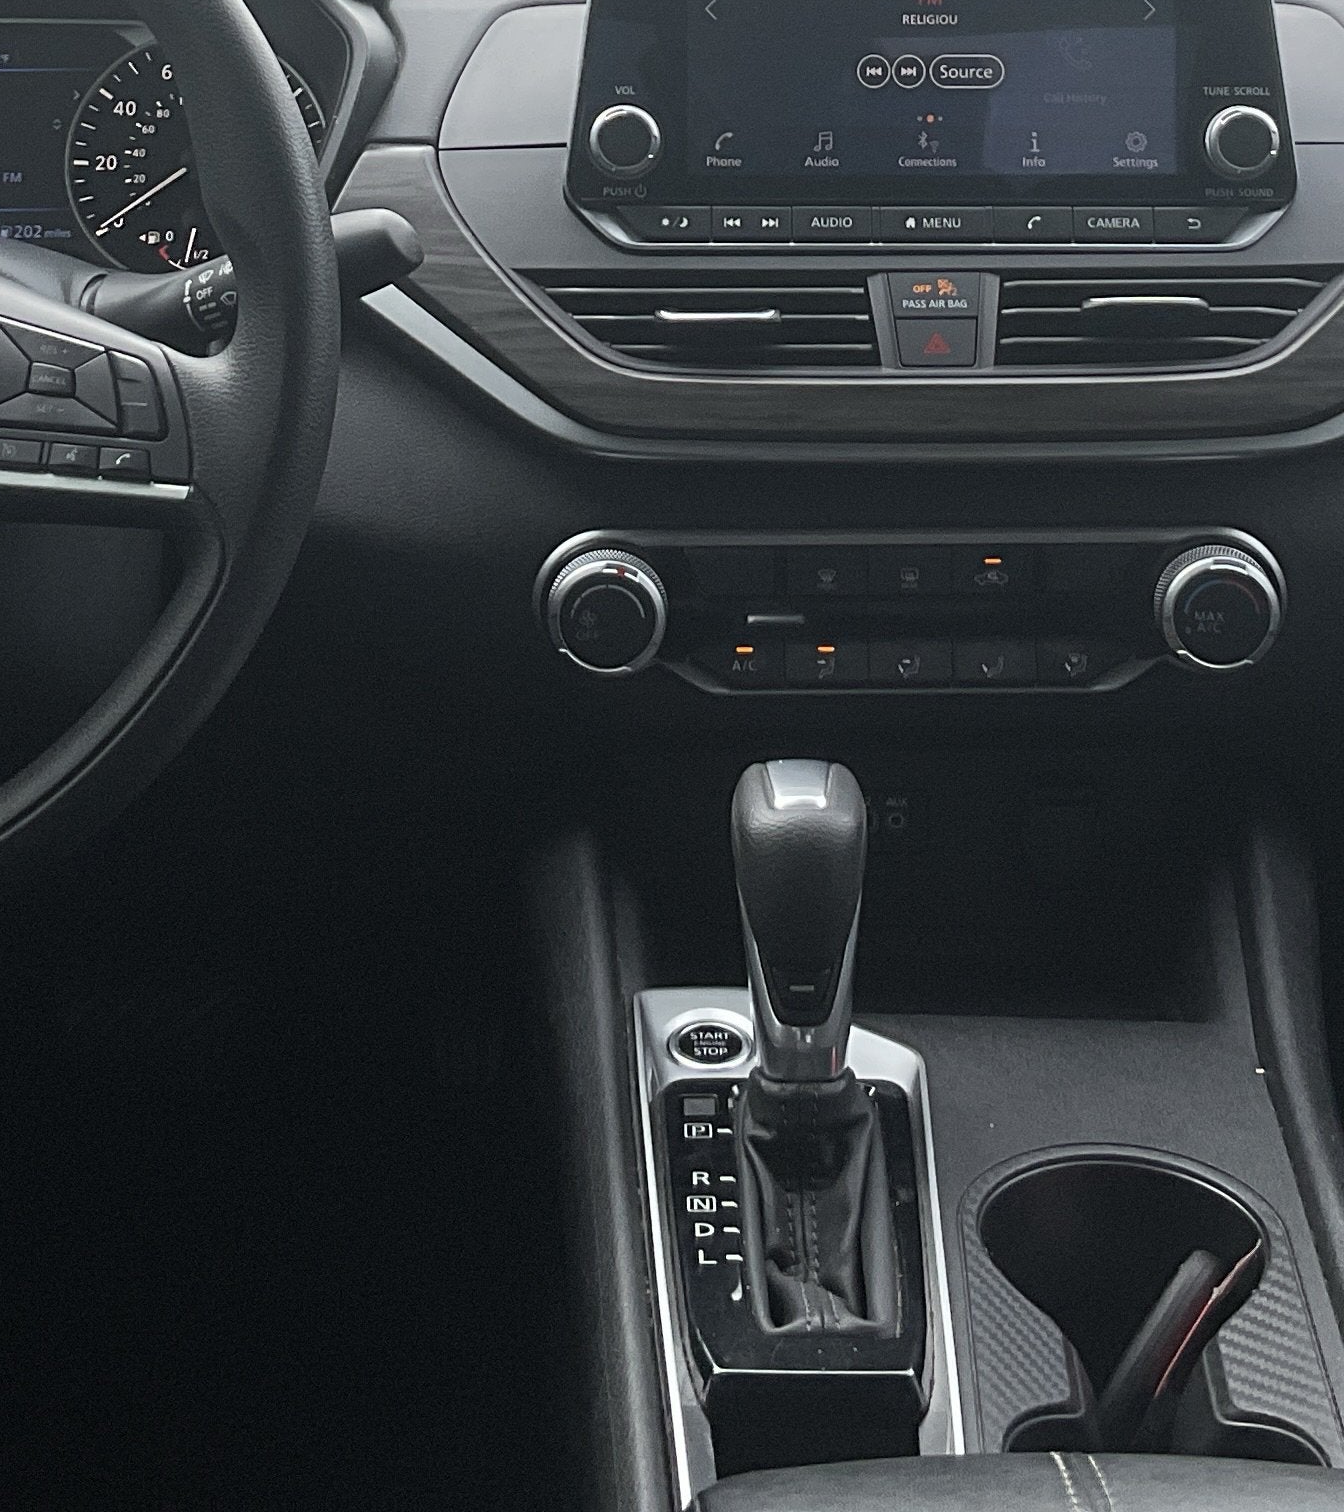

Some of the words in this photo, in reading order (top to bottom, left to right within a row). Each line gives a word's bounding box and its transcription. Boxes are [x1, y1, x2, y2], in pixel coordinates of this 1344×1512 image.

[902, 14, 958, 25] RELIGIOU
[939, 64, 993, 80] Source
[615, 86, 636, 96] VOL
[1203, 86, 1230, 96] TUNE
[1233, 86, 1270, 96] SCROLL
[113, 100, 137, 116] 40
[156, 108, 170, 118] 80
[142, 124, 155, 134] 60
[132, 148, 146, 158] 40
[95, 155, 117, 171] 20
[706, 156, 742, 167] Phone
[804, 156, 840, 167] Audio
[898, 156, 957, 167] Connections
[1022, 156, 1046, 167] Info
[1112, 156, 1158, 169] Settings
[2, 171, 22, 183] FM
[133, 174, 146, 184] 20
[603, 187, 631, 197] PUSH
[810, 217, 853, 228] AUDIO
[923, 217, 961, 229] MENU
[1087, 217, 1140, 229] CAMERA
[14, 225, 42, 238] 202
[166, 230, 174, 242] 0
[196, 286, 213, 300] OFF
[912, 284, 932, 293] OFF
[902, 299, 927, 308] PASS
[928, 299, 945, 308] AIR
[947, 299, 967, 308] BAG
[732, 659, 758, 672] A/C
[690, 1031, 729, 1040] START
[694, 1047, 728, 1056] STOP
[691, 1125, 706, 1137] P
[692, 1171, 710, 1186] R
[693, 1197, 710, 1210] N
[694, 1222, 715, 1238] D
[698, 1249, 718, 1265] L
